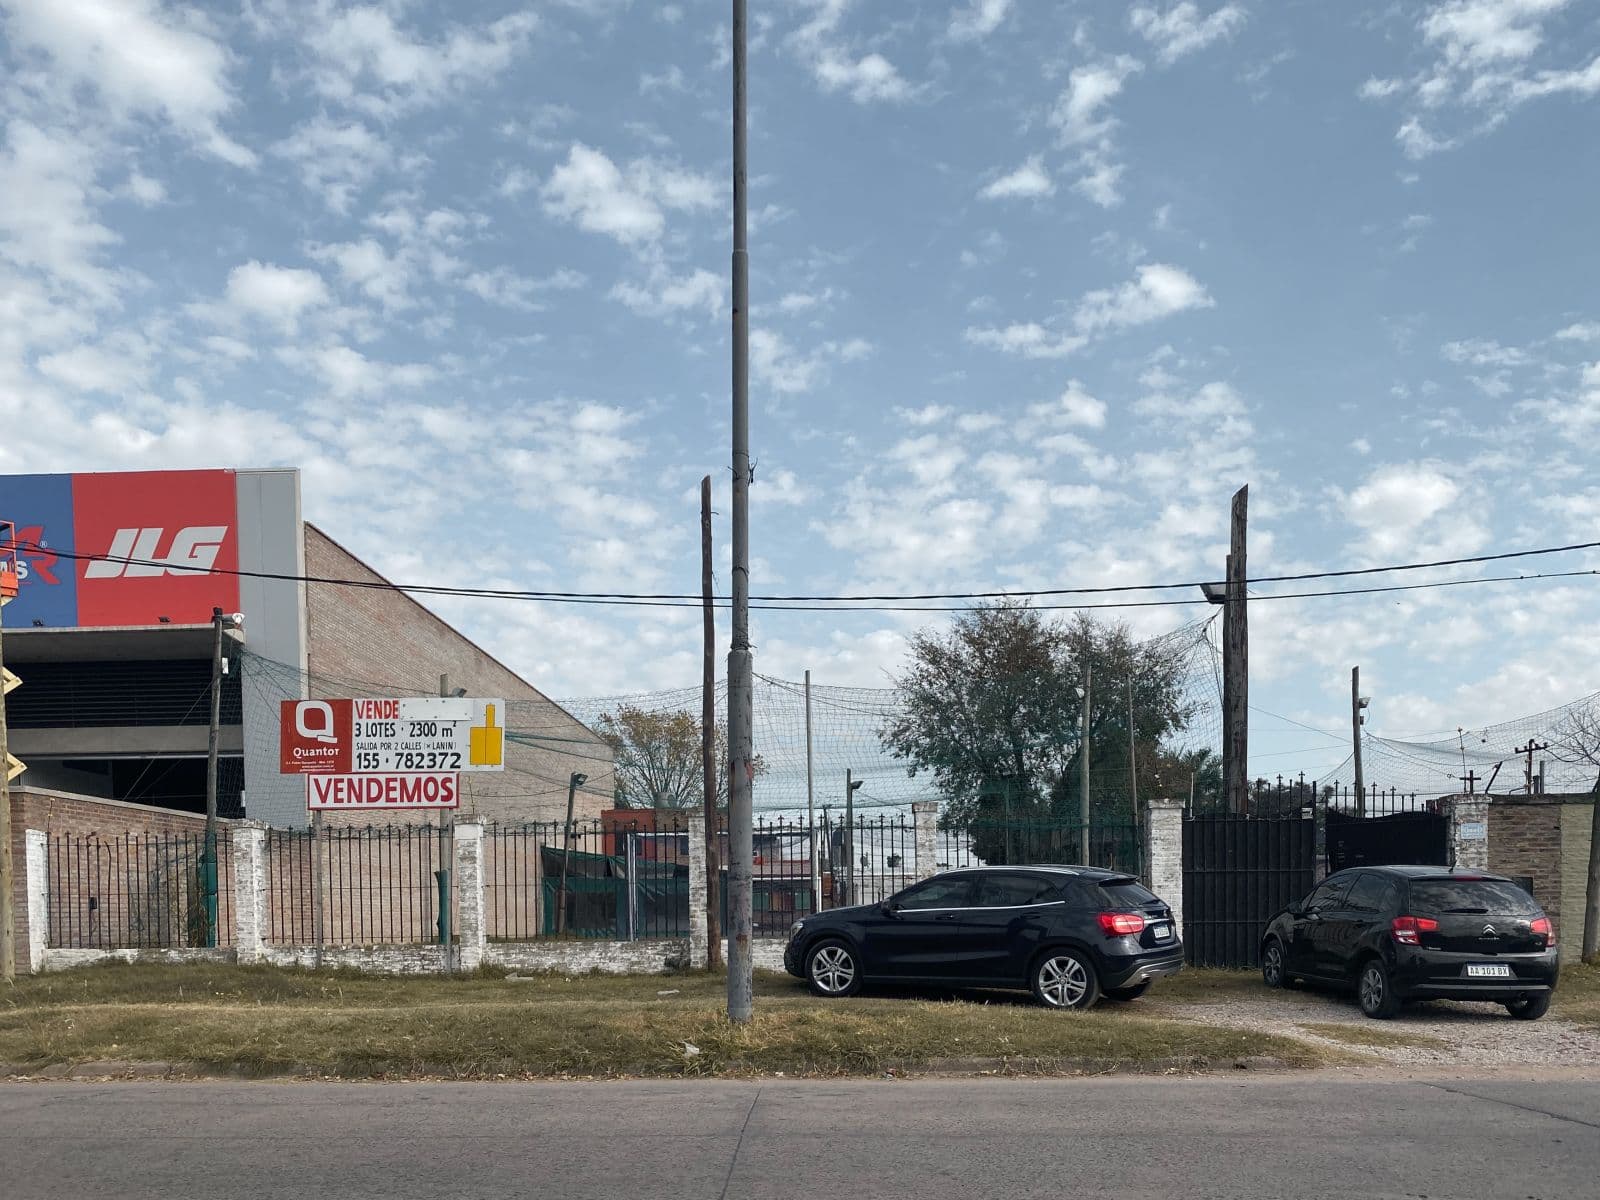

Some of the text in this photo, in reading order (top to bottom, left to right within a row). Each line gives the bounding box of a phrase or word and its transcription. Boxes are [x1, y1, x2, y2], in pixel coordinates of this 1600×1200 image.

[84, 526, 229, 579] JLG
[355, 700, 399, 719] VENDE
[355, 723, 362, 738] 3
[366, 722, 396, 737] LOTES
[409, 722, 437, 737] 2300
[293, 747, 340, 759] Quantor
[356, 742, 378, 750] SALIDA
[380, 742, 392, 750] POR
[394, 742, 399, 750] 2
[400, 742, 422, 750] CALLES
[356, 752, 462, 769] 155 782372
[313, 776, 454, 804] VENDEMOS
[1470, 967, 1480, 975] AA
[1482, 967, 1496, 975] 101
